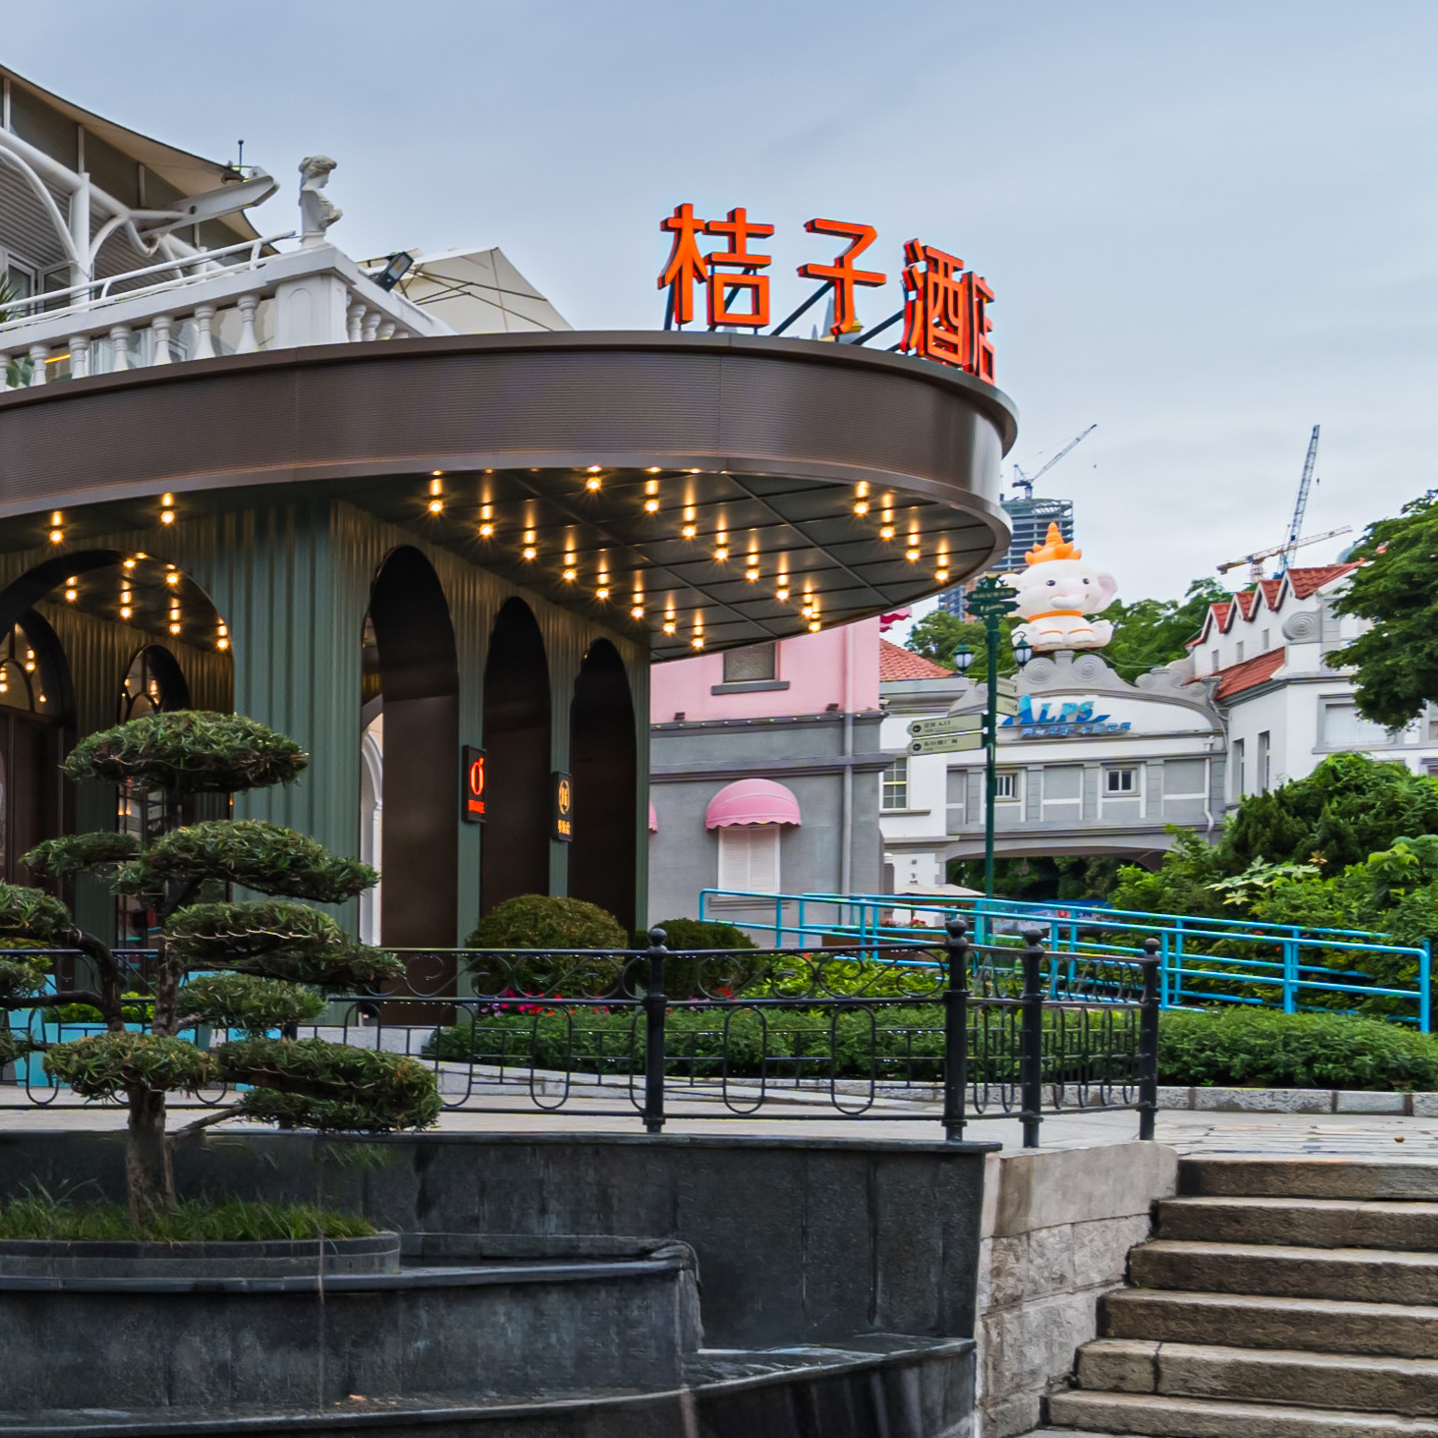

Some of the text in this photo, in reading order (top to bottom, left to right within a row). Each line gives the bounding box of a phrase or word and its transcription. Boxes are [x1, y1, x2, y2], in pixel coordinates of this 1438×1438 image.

[657, 203, 996, 386] 桔子酒店
[1002, 694, 1096, 724] ALPS
